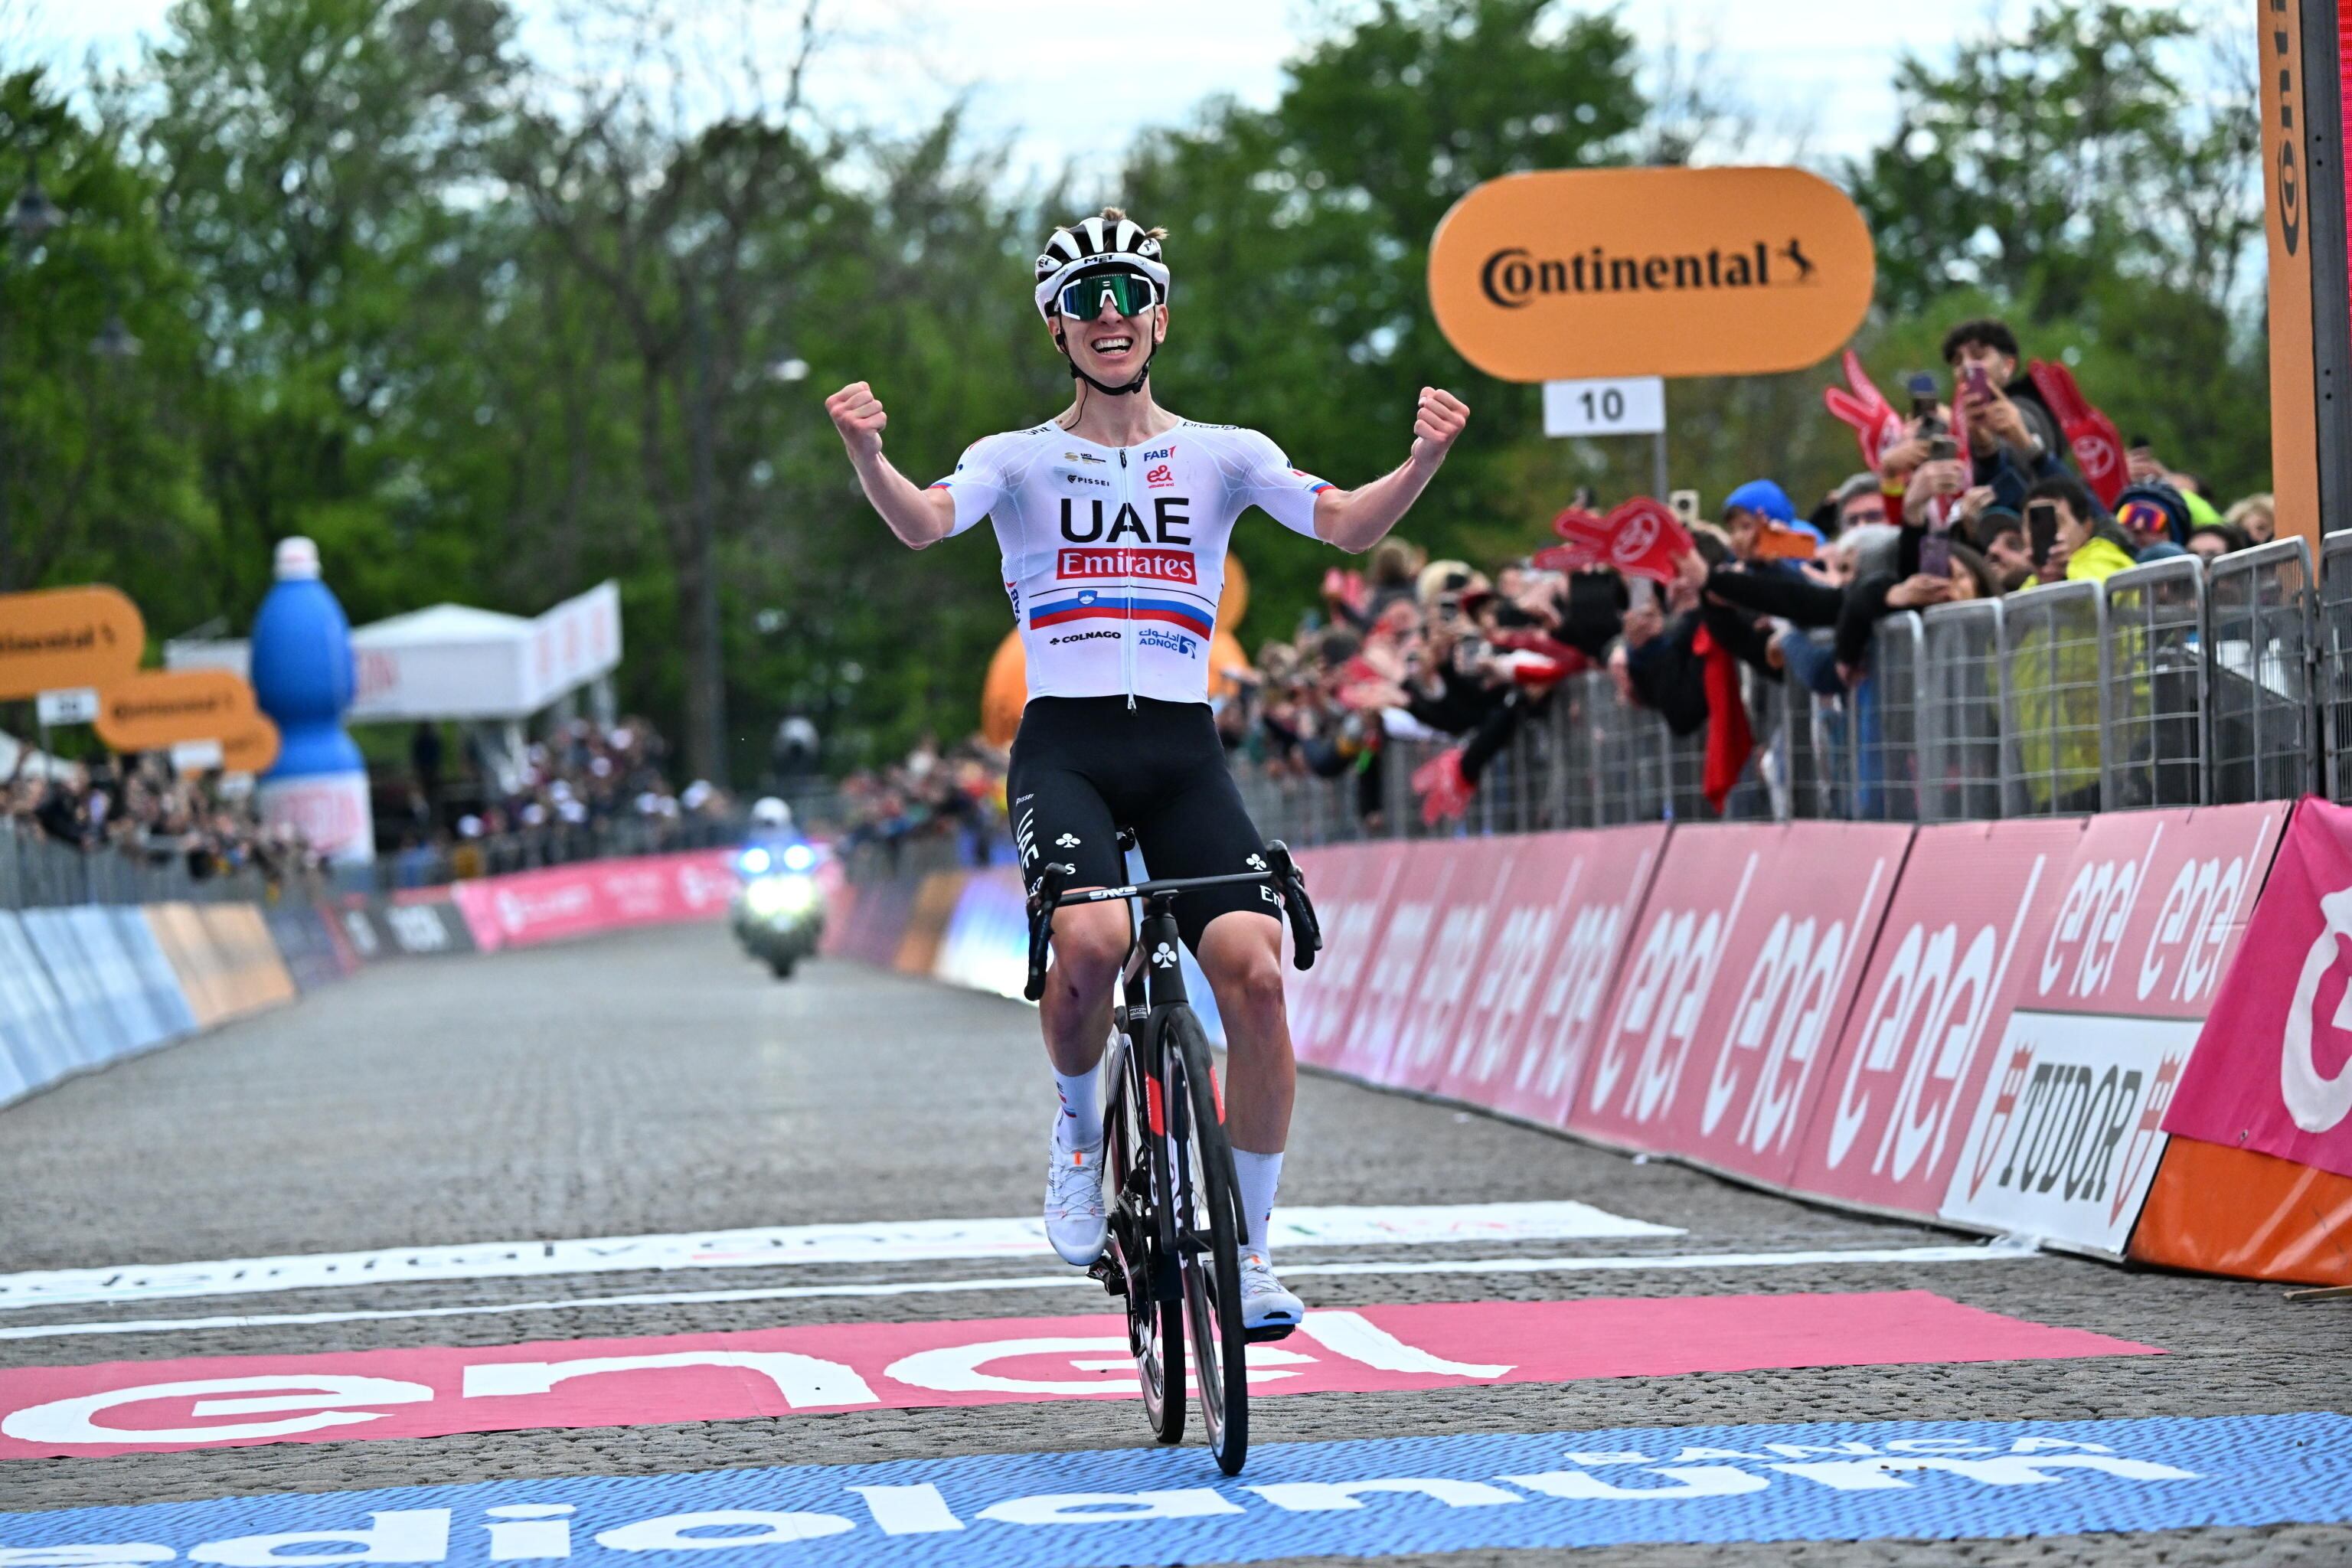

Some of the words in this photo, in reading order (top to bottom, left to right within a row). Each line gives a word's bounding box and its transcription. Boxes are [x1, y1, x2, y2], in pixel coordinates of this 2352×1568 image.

[1037, 256, 1054, 268] ET
[1084, 253, 1116, 264] MET
[1480, 240, 1769, 309] Continental
[1579, 387, 1625, 422] 10
[1144, 449, 1168, 462] FAB
[1077, 476, 1109, 487] PISSEI
[1060, 497, 1191, 546] UAE
[1062, 550, 1193, 580] Emirates
[1062, 631, 1122, 644] COLNAGO
[1138, 638, 1178, 651] ADNOC
[2039, 821, 2164, 998] enel
[2136, 815, 2271, 1004] enel
[1590, 850, 1759, 1124] enel
[1701, 857, 1885, 1155] enel
[1828, 854, 2047, 1181] enel
[1998, 1062, 2144, 1203] TUDOR
[2, 1311, 1517, 1445] enel
[1563, 1436, 2118, 1466] BANCA
[0, 1453, 2202, 1568] ediolanum
